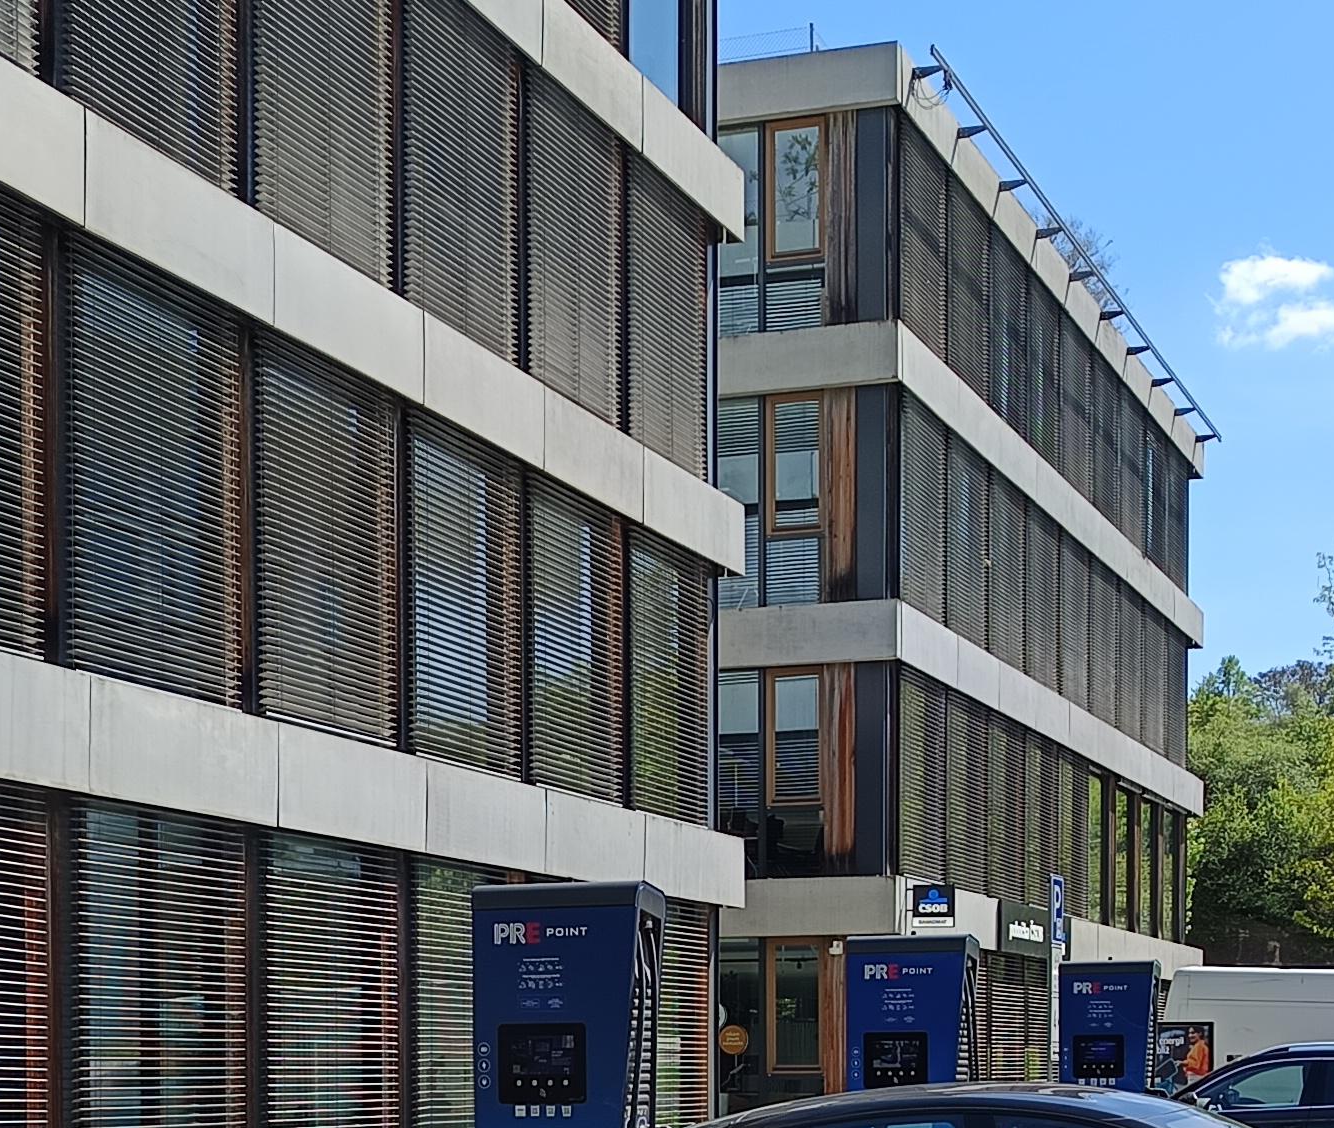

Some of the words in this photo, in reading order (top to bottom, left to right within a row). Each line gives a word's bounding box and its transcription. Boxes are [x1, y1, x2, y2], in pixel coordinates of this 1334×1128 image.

[494, 922, 541, 945] PRE
[546, 926, 588, 938] POINT
[864, 964, 899, 980] PRE
[902, 967, 933, 975] POINT
[1073, 981, 1101, 995] PRE
